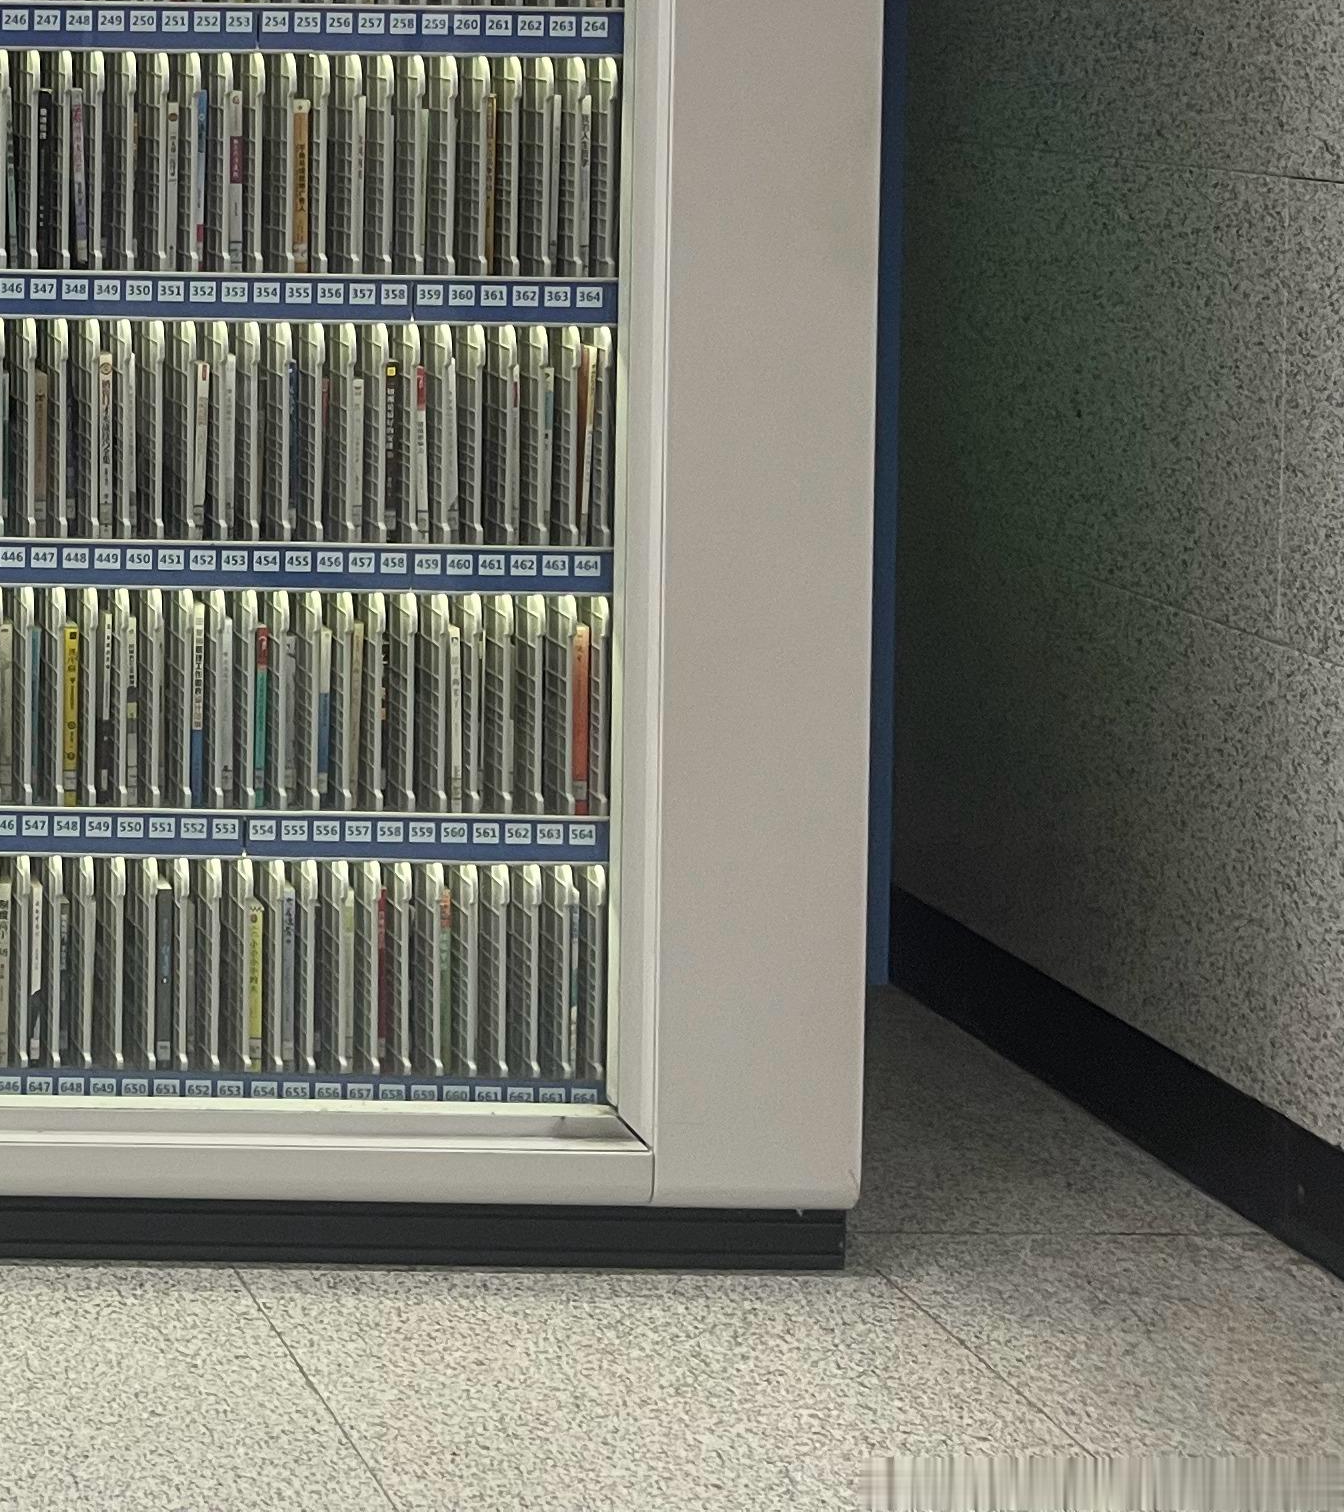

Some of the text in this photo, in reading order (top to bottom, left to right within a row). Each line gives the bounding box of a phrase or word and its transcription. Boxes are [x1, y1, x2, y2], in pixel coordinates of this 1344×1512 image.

[5, 14, 26, 25] 246
[164, 15, 185, 26] 251
[329, 17, 350, 27] 256
[488, 19, 509, 30] 261
[584, 21, 605, 31] 264
[2, 283, 22, 293] 346
[160, 285, 181, 296] 351
[320, 288, 341, 298] 356
[484, 290, 504, 300] 361
[579, 291, 600, 302] 364
[1, 551, 23, 562] 446
[160, 554, 181, 564] 451
[319, 557, 341, 567] 456
[481, 559, 502, 570] 461
[576, 560, 598, 571] 464
[152, 822, 172, 832] 551
[316, 825, 337, 836] 556
[476, 827, 496, 838] 561
[572, 829, 593, 839] 564
[155, 1083, 177, 1094] 651
[317, 1086, 339, 1097] 656
